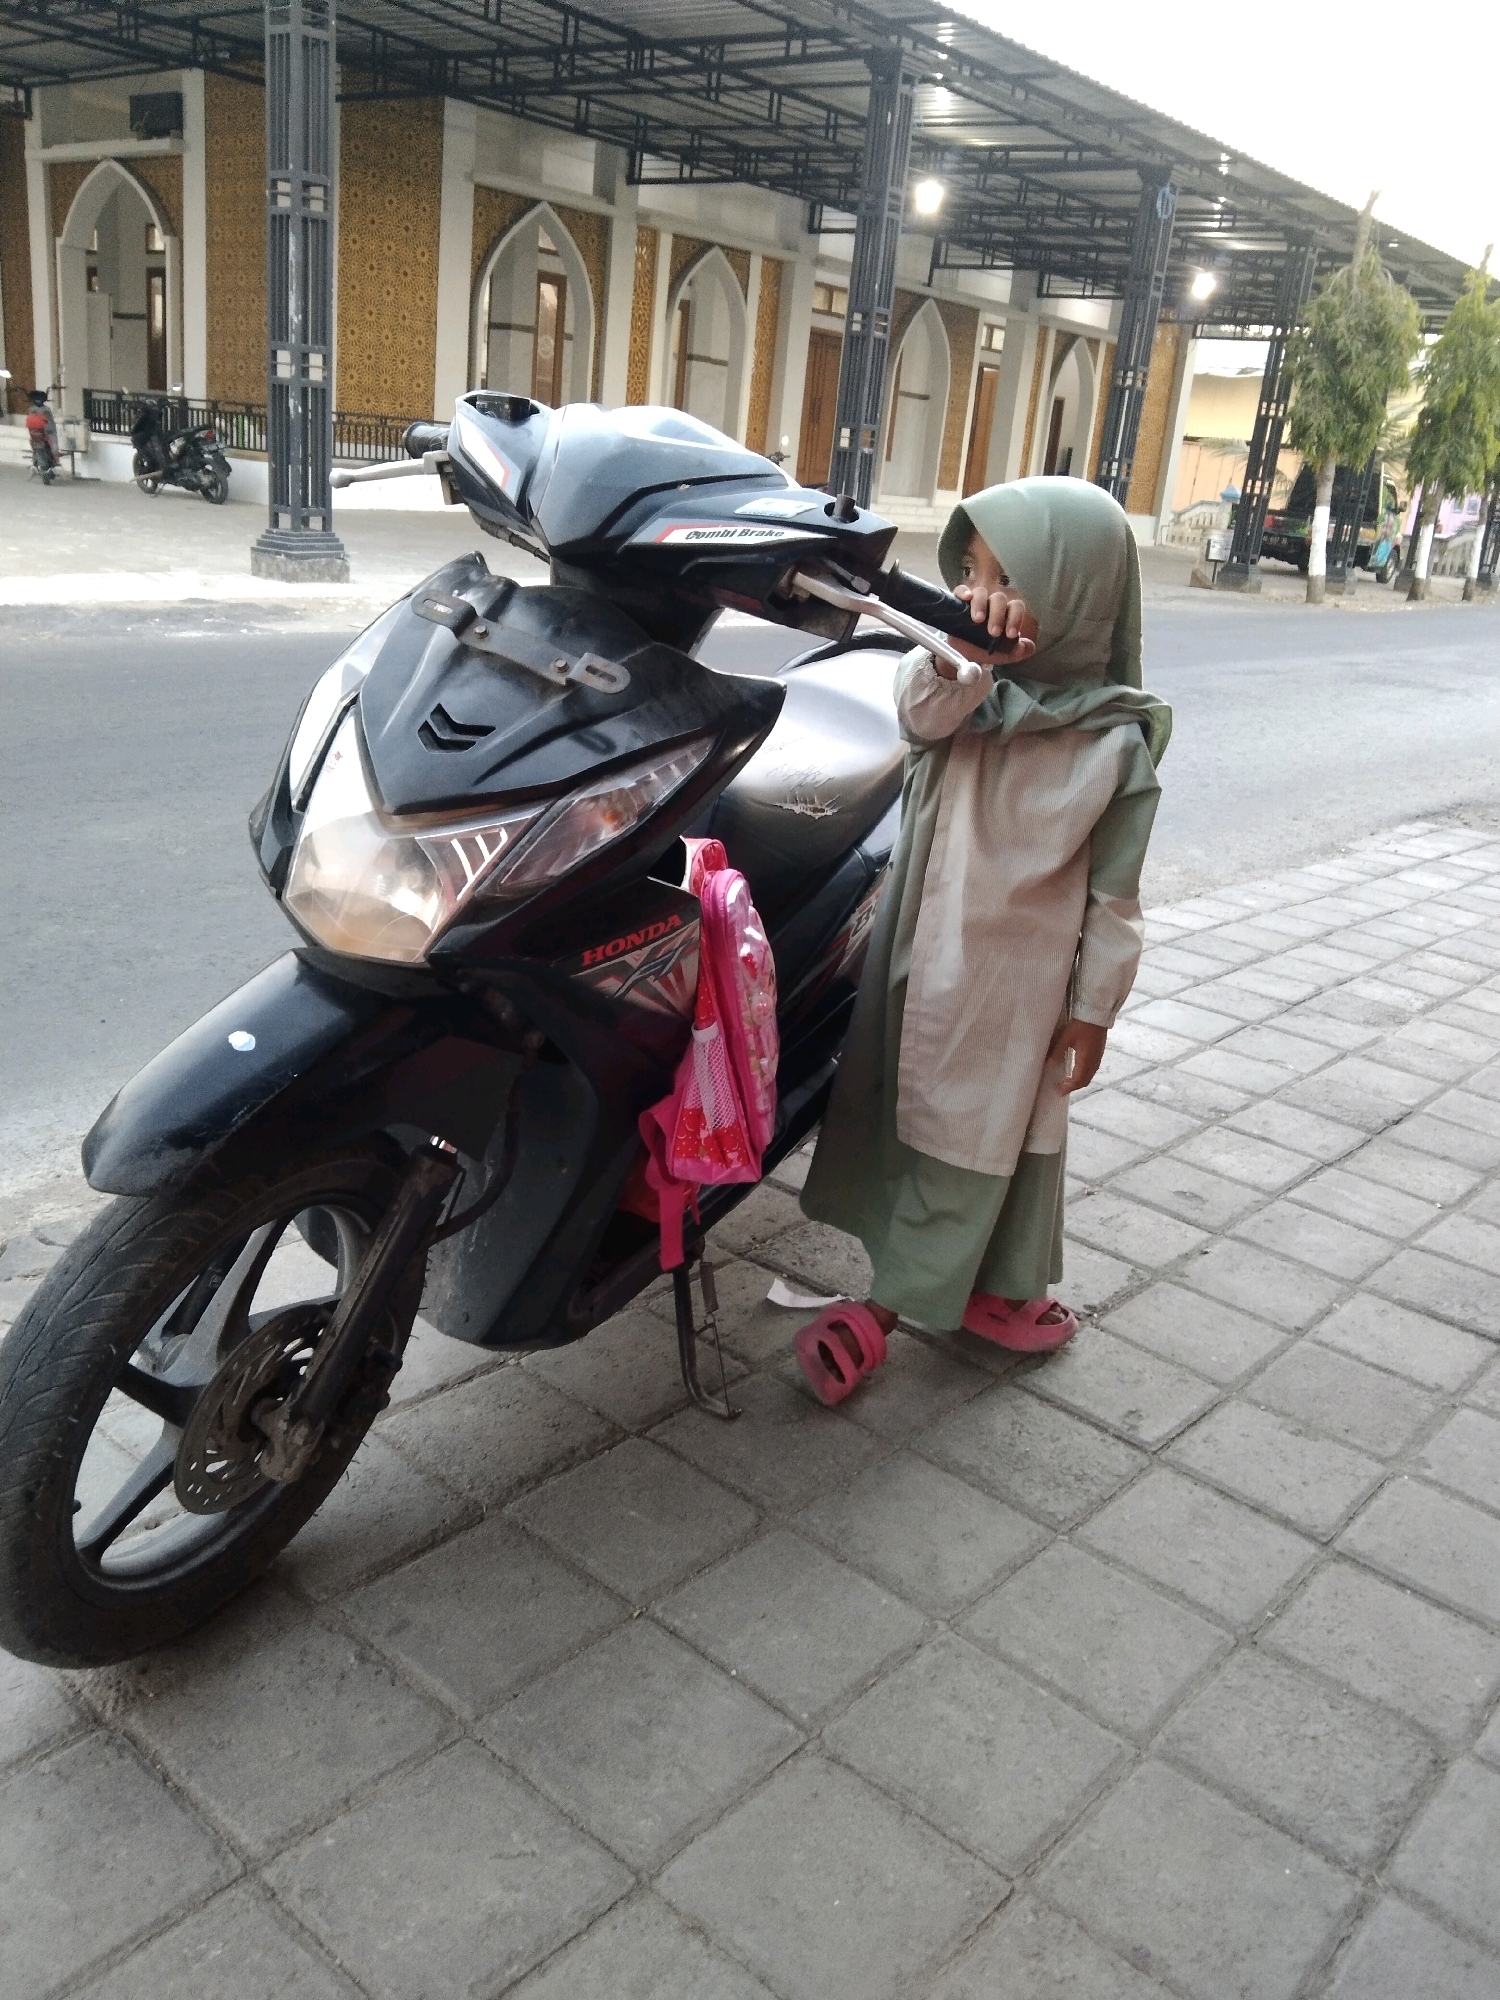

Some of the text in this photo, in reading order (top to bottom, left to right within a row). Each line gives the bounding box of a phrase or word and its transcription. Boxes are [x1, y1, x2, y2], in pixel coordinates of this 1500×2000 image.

[685, 528, 785, 540] Combi Brake
[581, 914, 683, 967] HONDA
